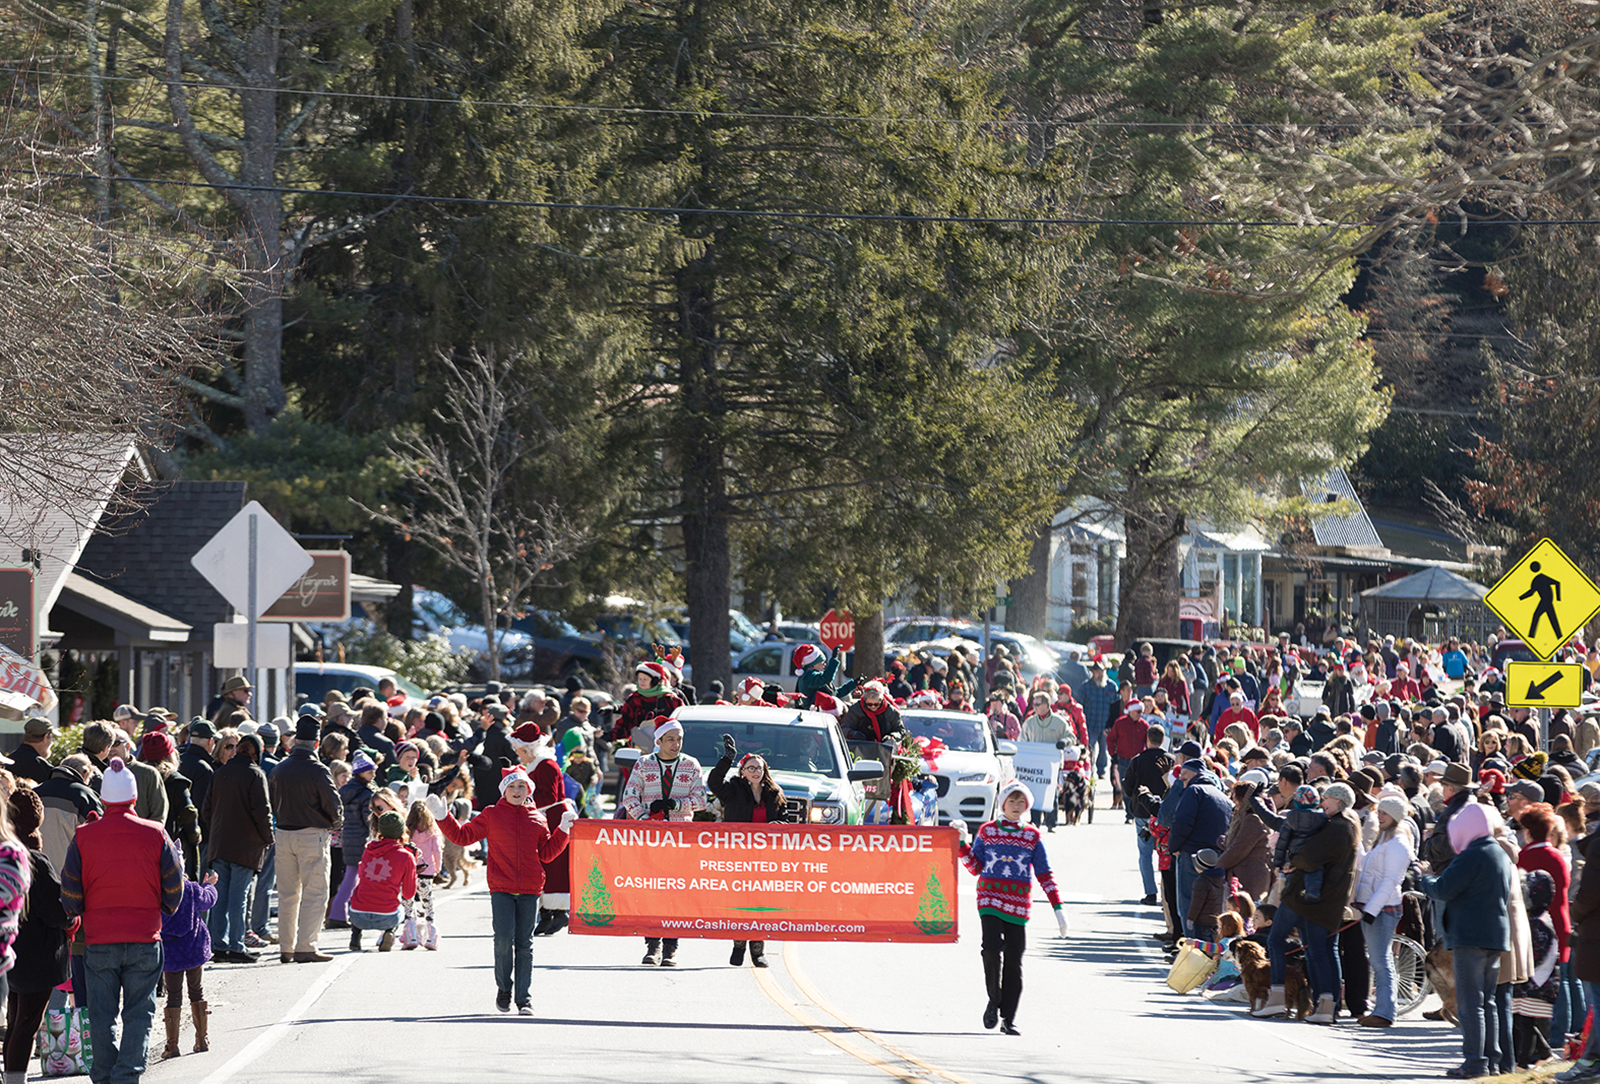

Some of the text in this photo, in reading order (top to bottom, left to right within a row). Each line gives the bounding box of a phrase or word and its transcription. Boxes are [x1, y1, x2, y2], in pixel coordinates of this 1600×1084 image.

[1020, 774, 1034, 783] DOG
[595, 828, 933, 853] ANNUAL CHRISTMAS PARADE
[700, 860, 828, 874] PRESENTED BY THE
[614, 876, 915, 895] CASHIERS AREA CHAMBER OF COMMERCE
[661, 919, 865, 933] www.CashiersAreaChamber.com
